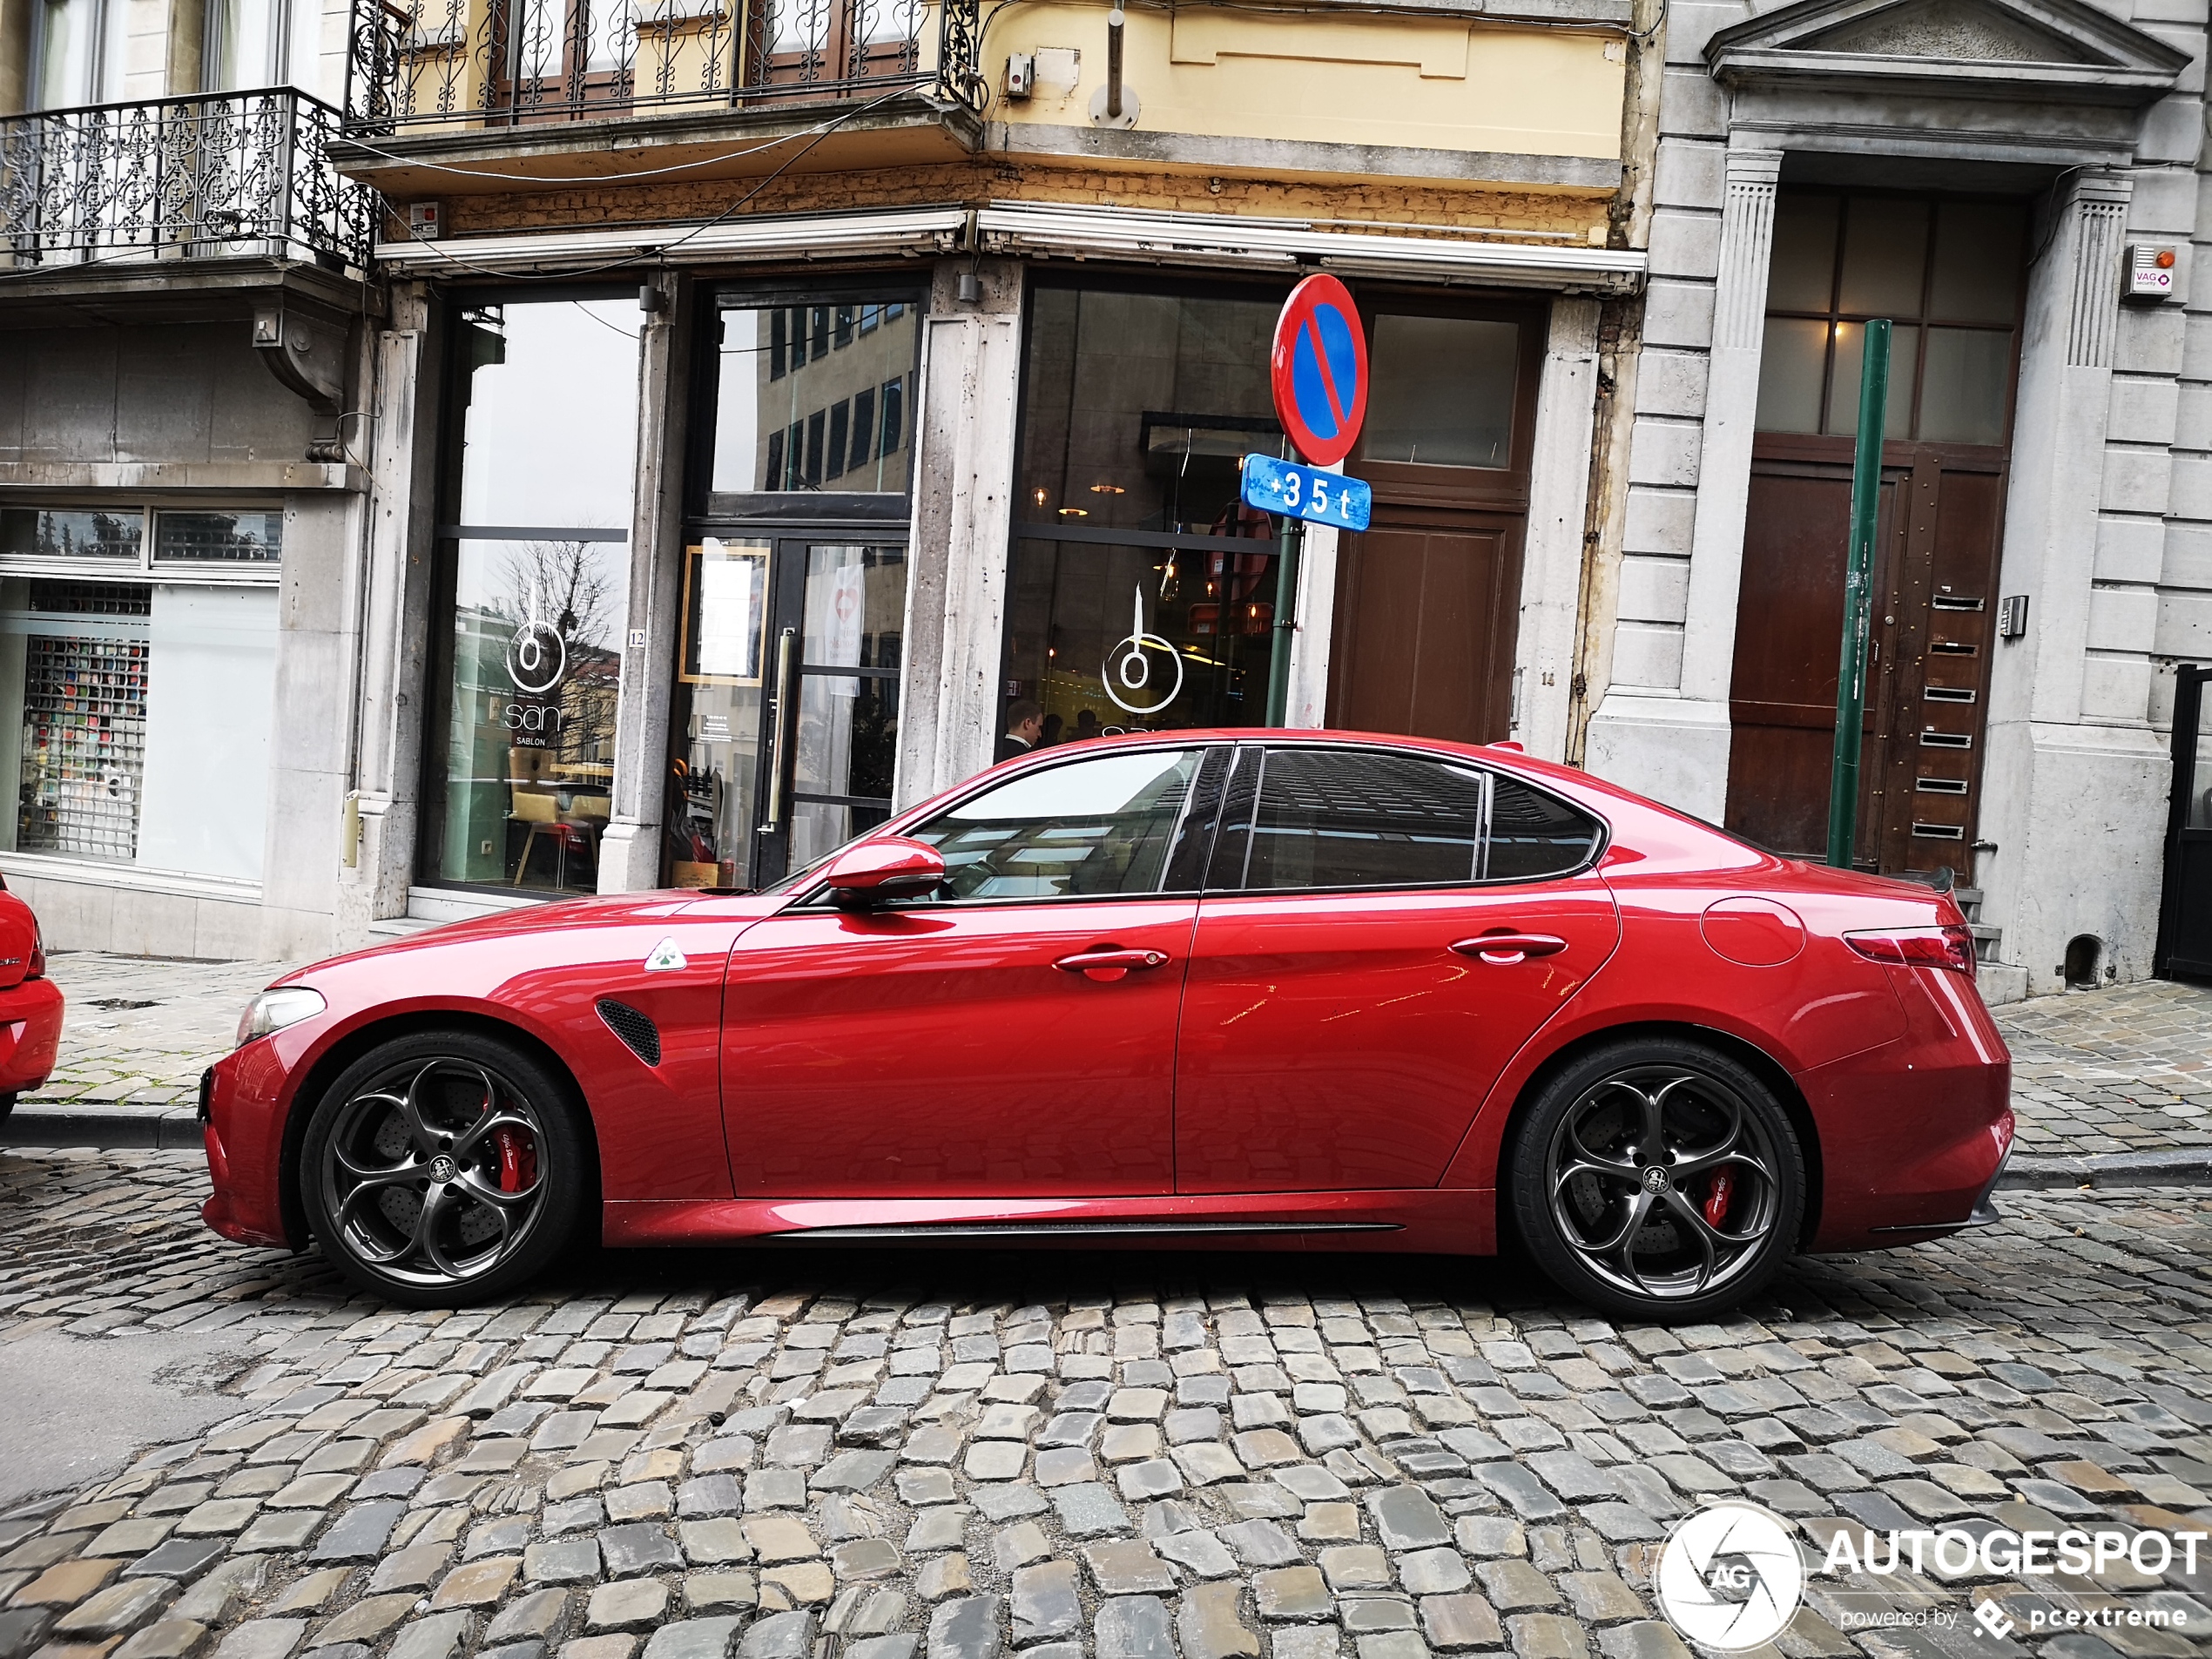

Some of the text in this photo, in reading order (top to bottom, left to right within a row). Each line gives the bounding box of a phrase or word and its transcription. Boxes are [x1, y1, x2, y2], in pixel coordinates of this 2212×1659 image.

[1340, 489, 1350, 520] t
[631, 632, 644, 645] 12
[1541, 671, 1554, 686] 14
[504, 704, 560, 732] san
[516, 737, 546, 746] SABLON
